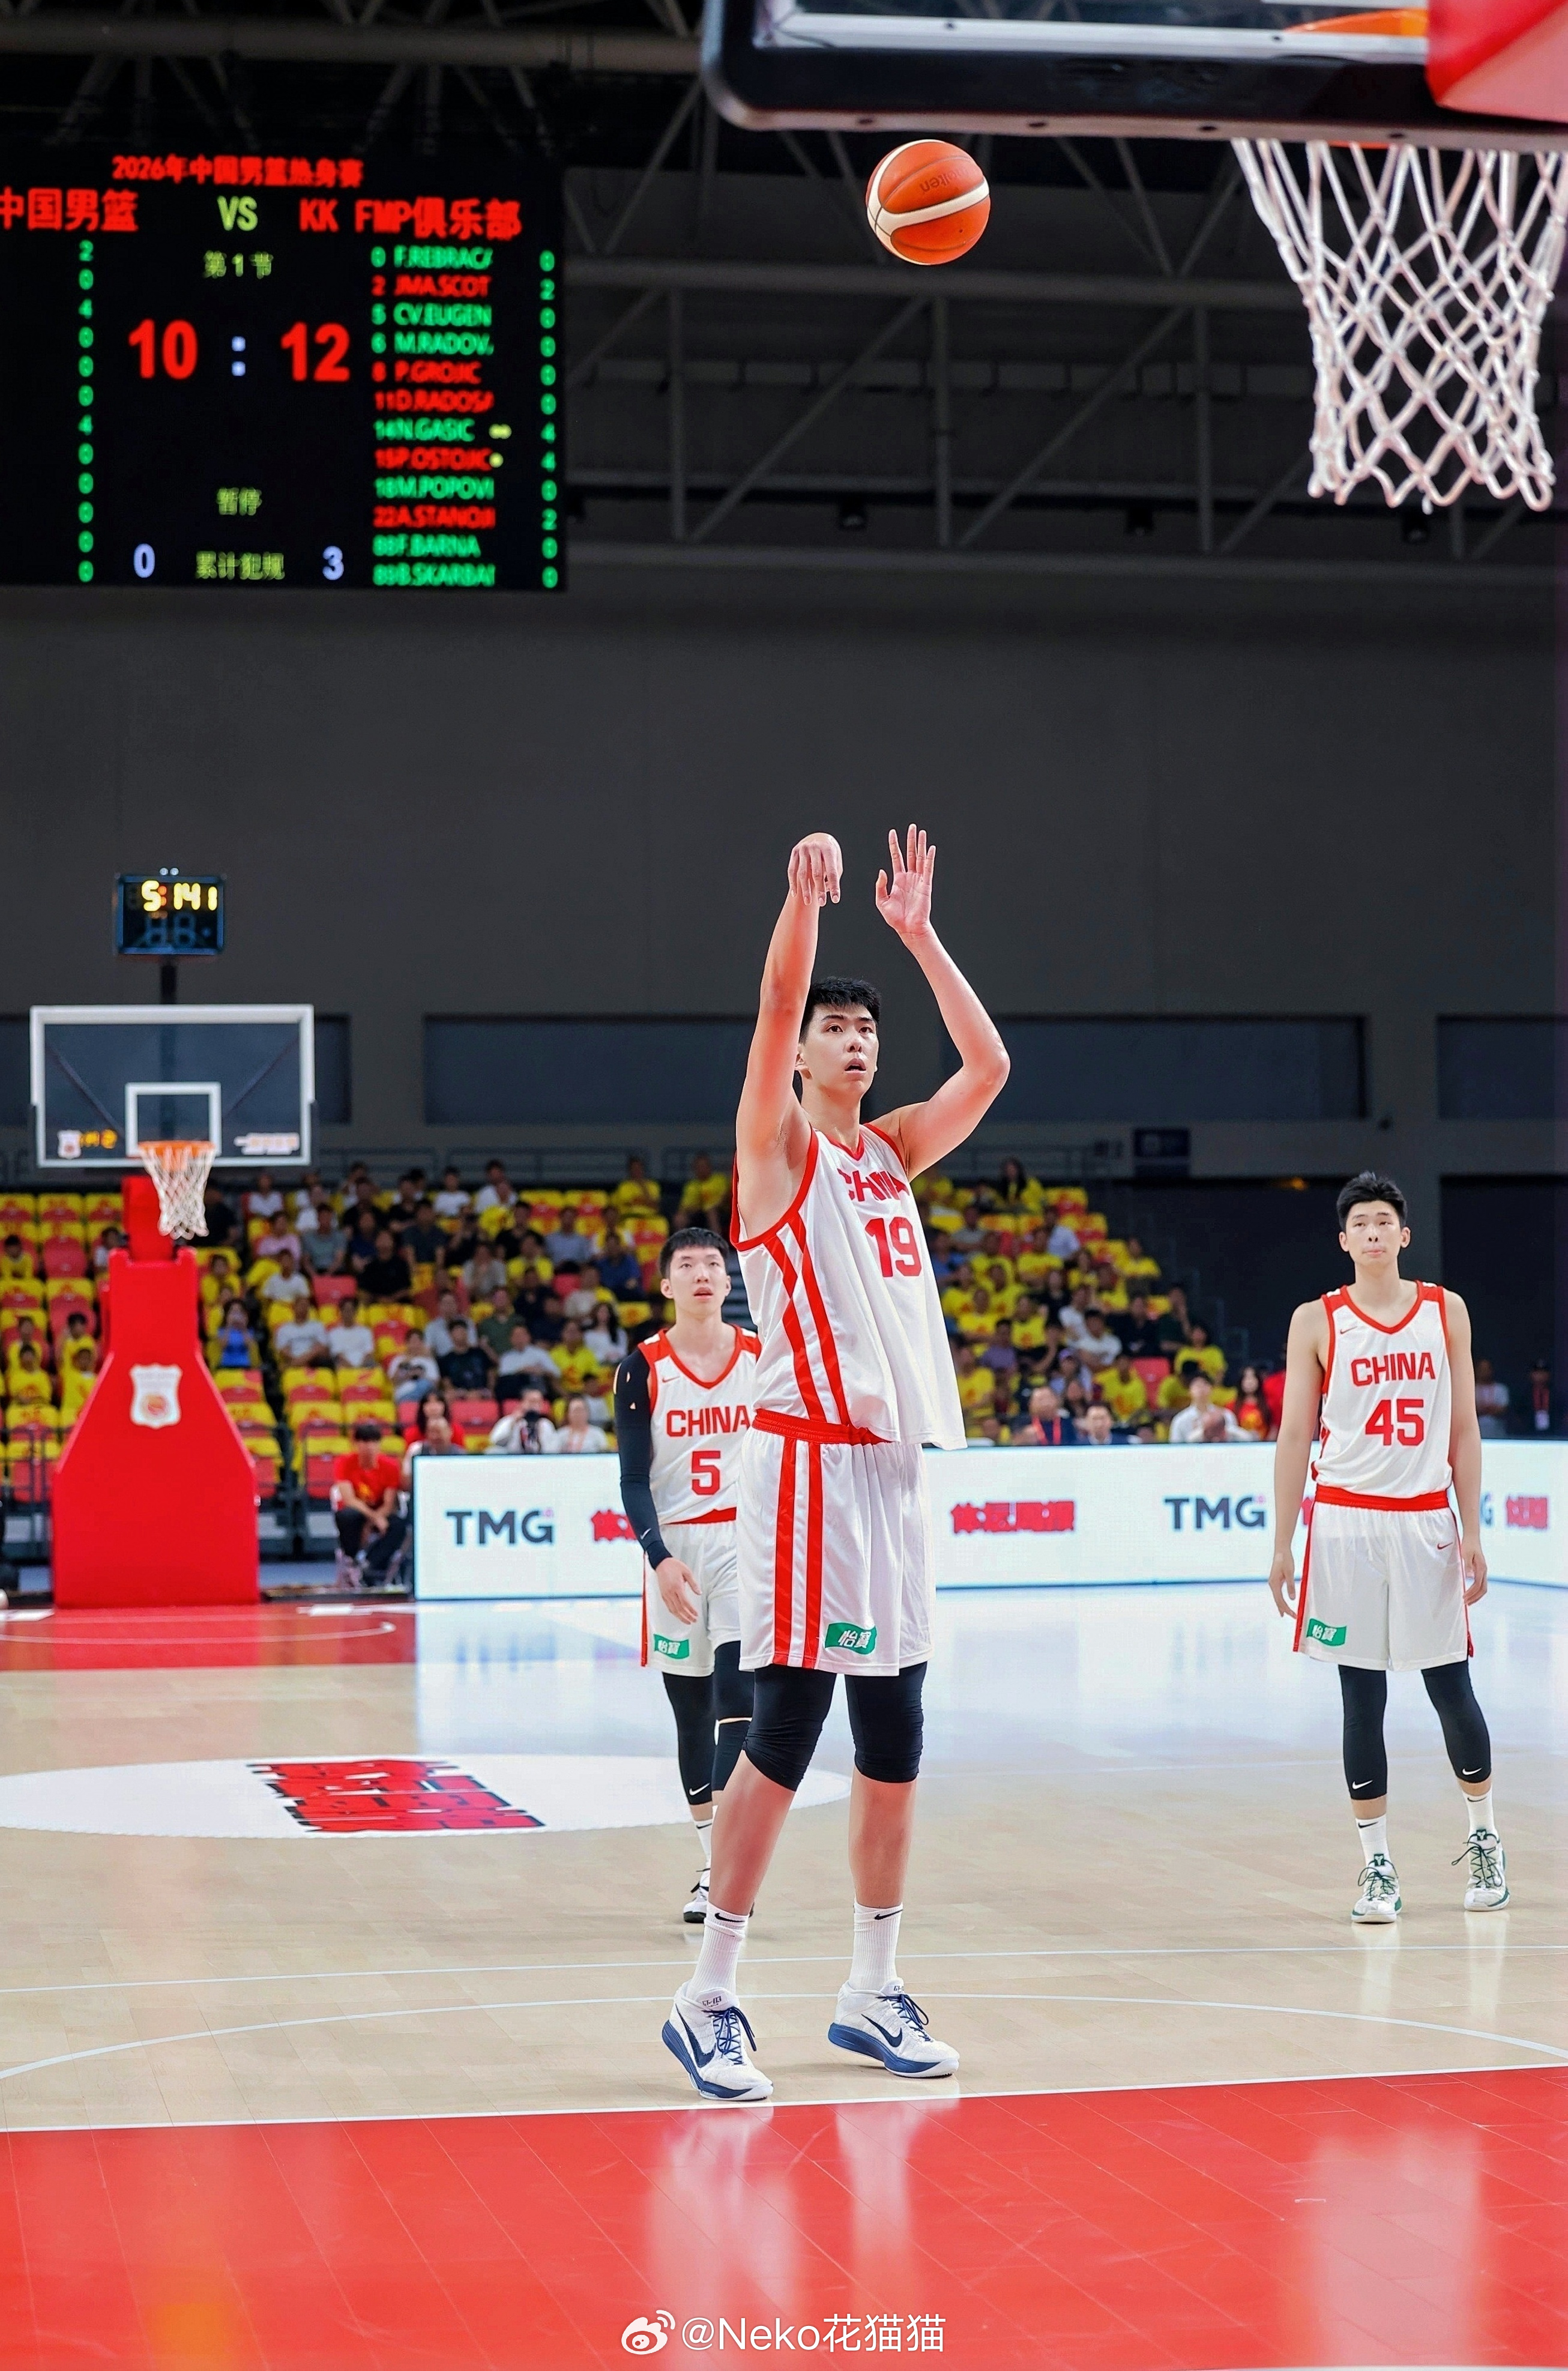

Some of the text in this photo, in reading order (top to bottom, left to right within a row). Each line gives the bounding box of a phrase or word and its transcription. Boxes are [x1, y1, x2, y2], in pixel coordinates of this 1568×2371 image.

[0, 187, 139, 232] 中国男篮
[217, 196, 258, 231] VS
[300, 199, 339, 232] KK
[79, 241, 93, 261] 2
[372, 247, 386, 268] 0
[540, 251, 555, 271] 0
[79, 270, 93, 290] 0
[372, 276, 386, 297] 2
[540, 279, 555, 300] 2
[79, 300, 93, 318] 4
[540, 308, 555, 328] 0
[79, 327, 93, 348] 0
[540, 337, 555, 357] 0
[129, 319, 198, 380] 10
[281, 322, 350, 381] 12
[79, 356, 93, 376] 0
[540, 365, 555, 385] 0
[79, 385, 93, 406] 0
[540, 394, 555, 414] 0
[79, 416, 93, 435] 4
[540, 423, 557, 442] 4
[79, 444, 93, 464] 0
[540, 452, 557, 471] 4
[79, 473, 93, 494] 0
[540, 480, 557, 501] 0
[79, 502, 93, 523] 0
[540, 509, 557, 530] 2
[79, 531, 93, 552] 0
[540, 537, 557, 558] 0
[79, 561, 93, 582] 0
[134, 544, 155, 578] 0
[323, 546, 344, 580] 3
[540, 567, 557, 588] 0
[864, 1216, 922, 1278] 19
[1351, 1352, 1436, 1387] CHINA
[666, 1405, 751, 1437] CHINA
[1365, 1398, 1425, 1446] 45
[691, 1451, 721, 1496] 5
[1164, 1497, 1265, 1530] TMG
[447, 1511, 552, 1544] TMG
